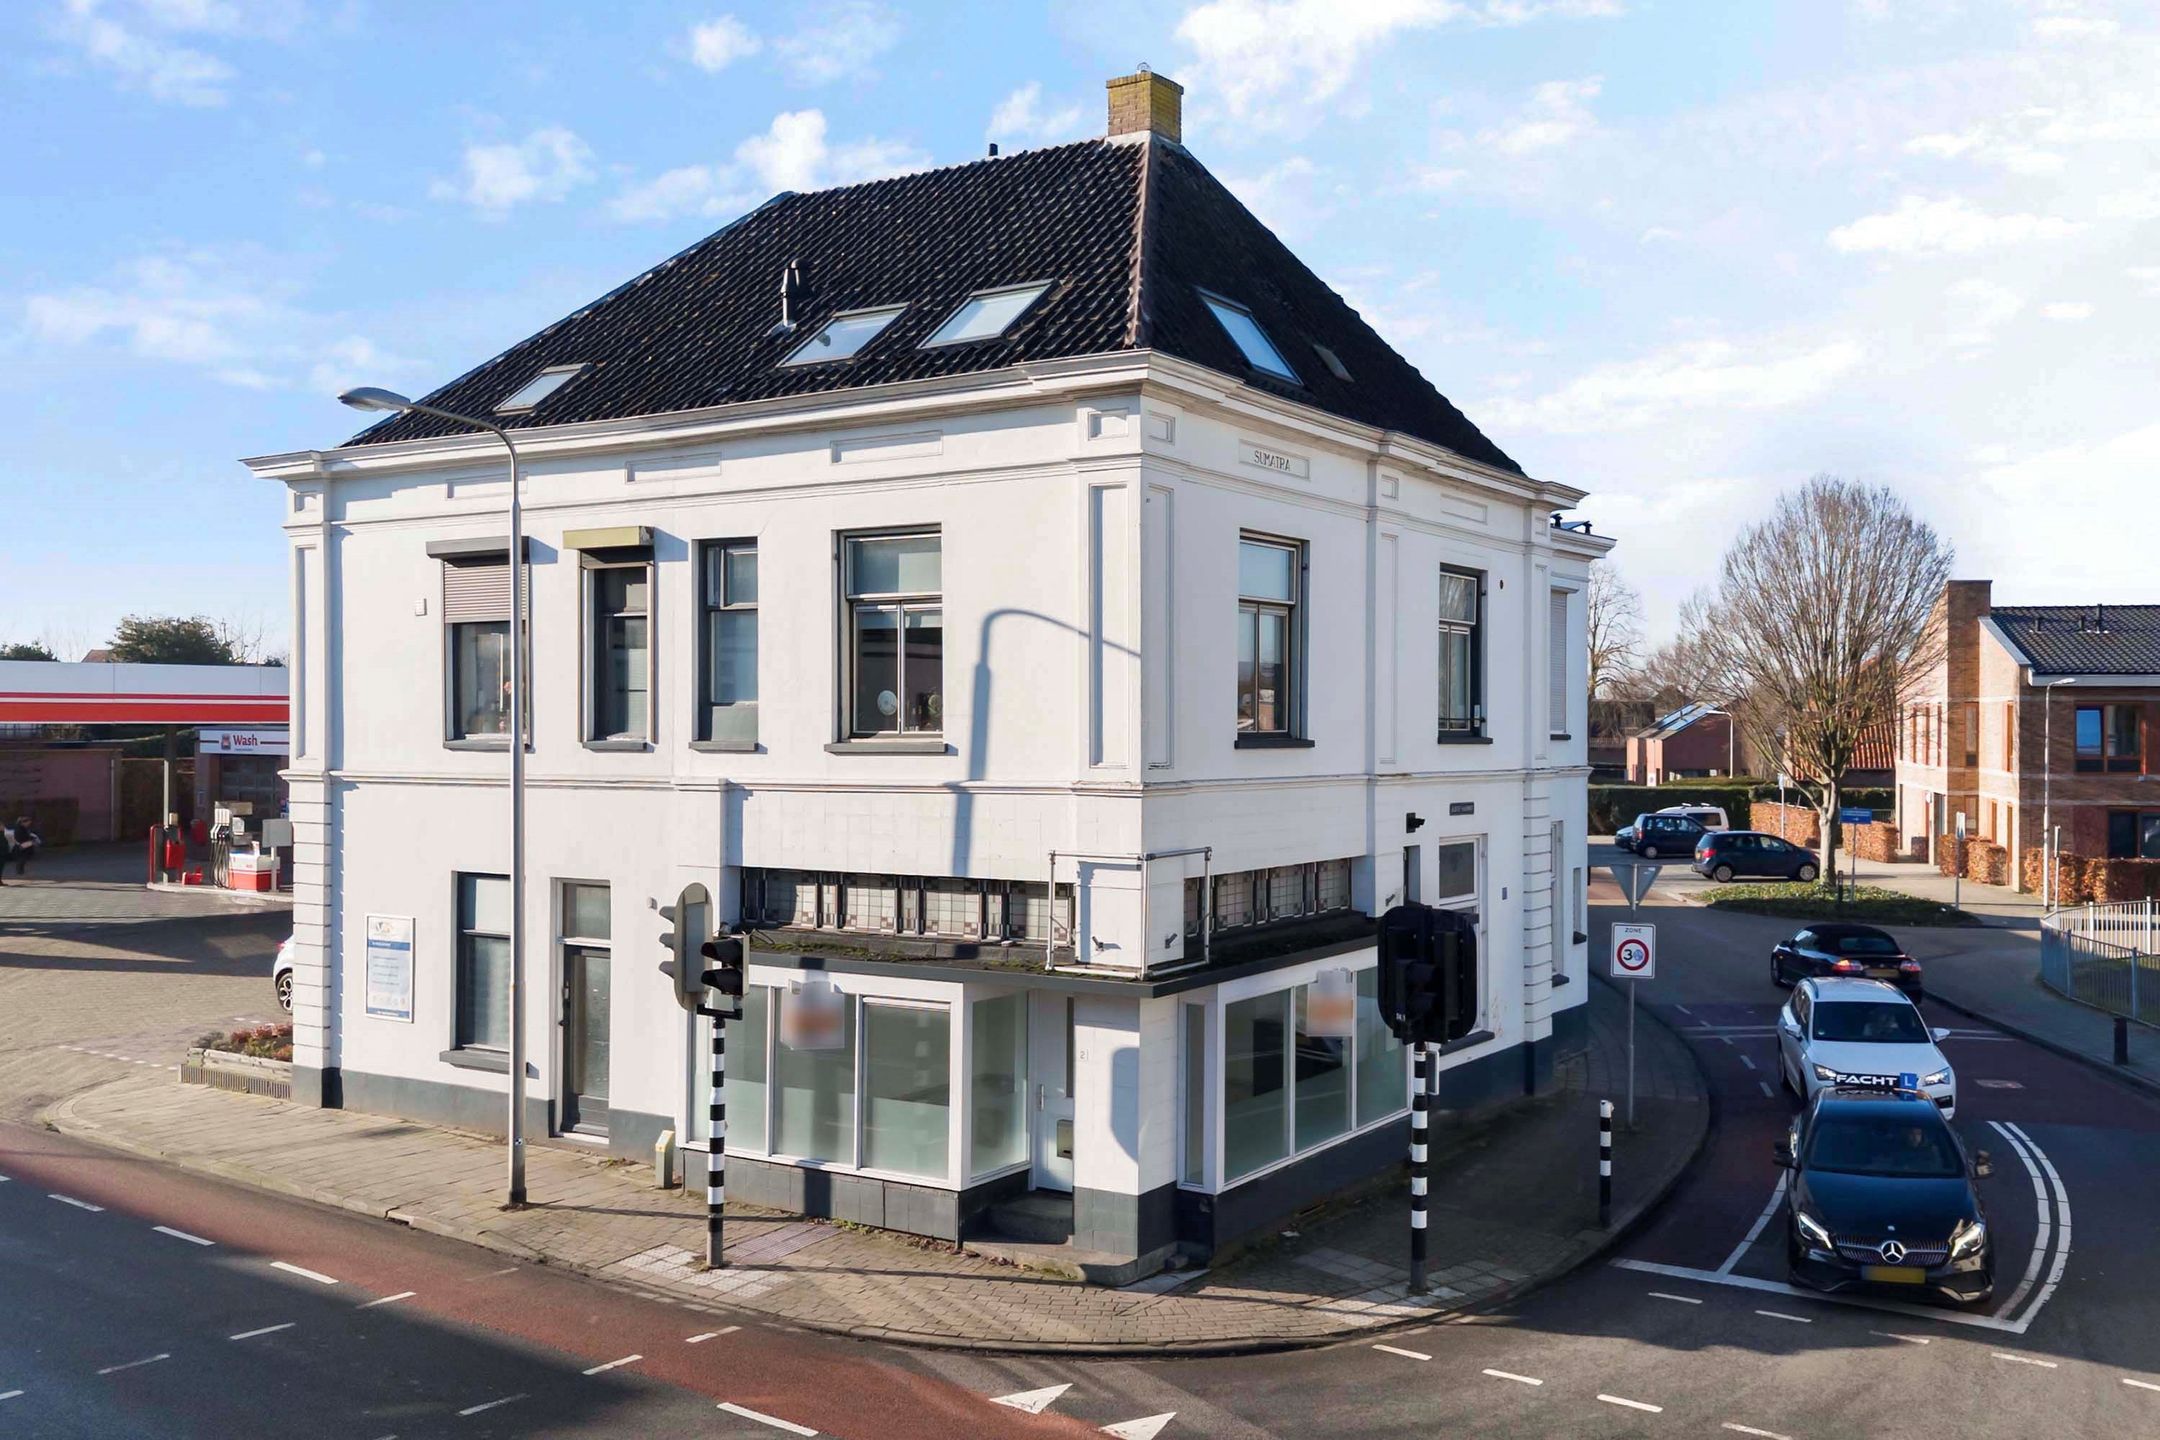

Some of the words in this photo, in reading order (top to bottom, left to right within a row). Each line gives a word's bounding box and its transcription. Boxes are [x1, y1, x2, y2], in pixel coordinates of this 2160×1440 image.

[1254, 450, 1291, 472] SUMATRA
[233, 734, 258, 746] Wash
[1836, 1074, 1898, 1086] FACHT
[1904, 1075, 1912, 1086] L
